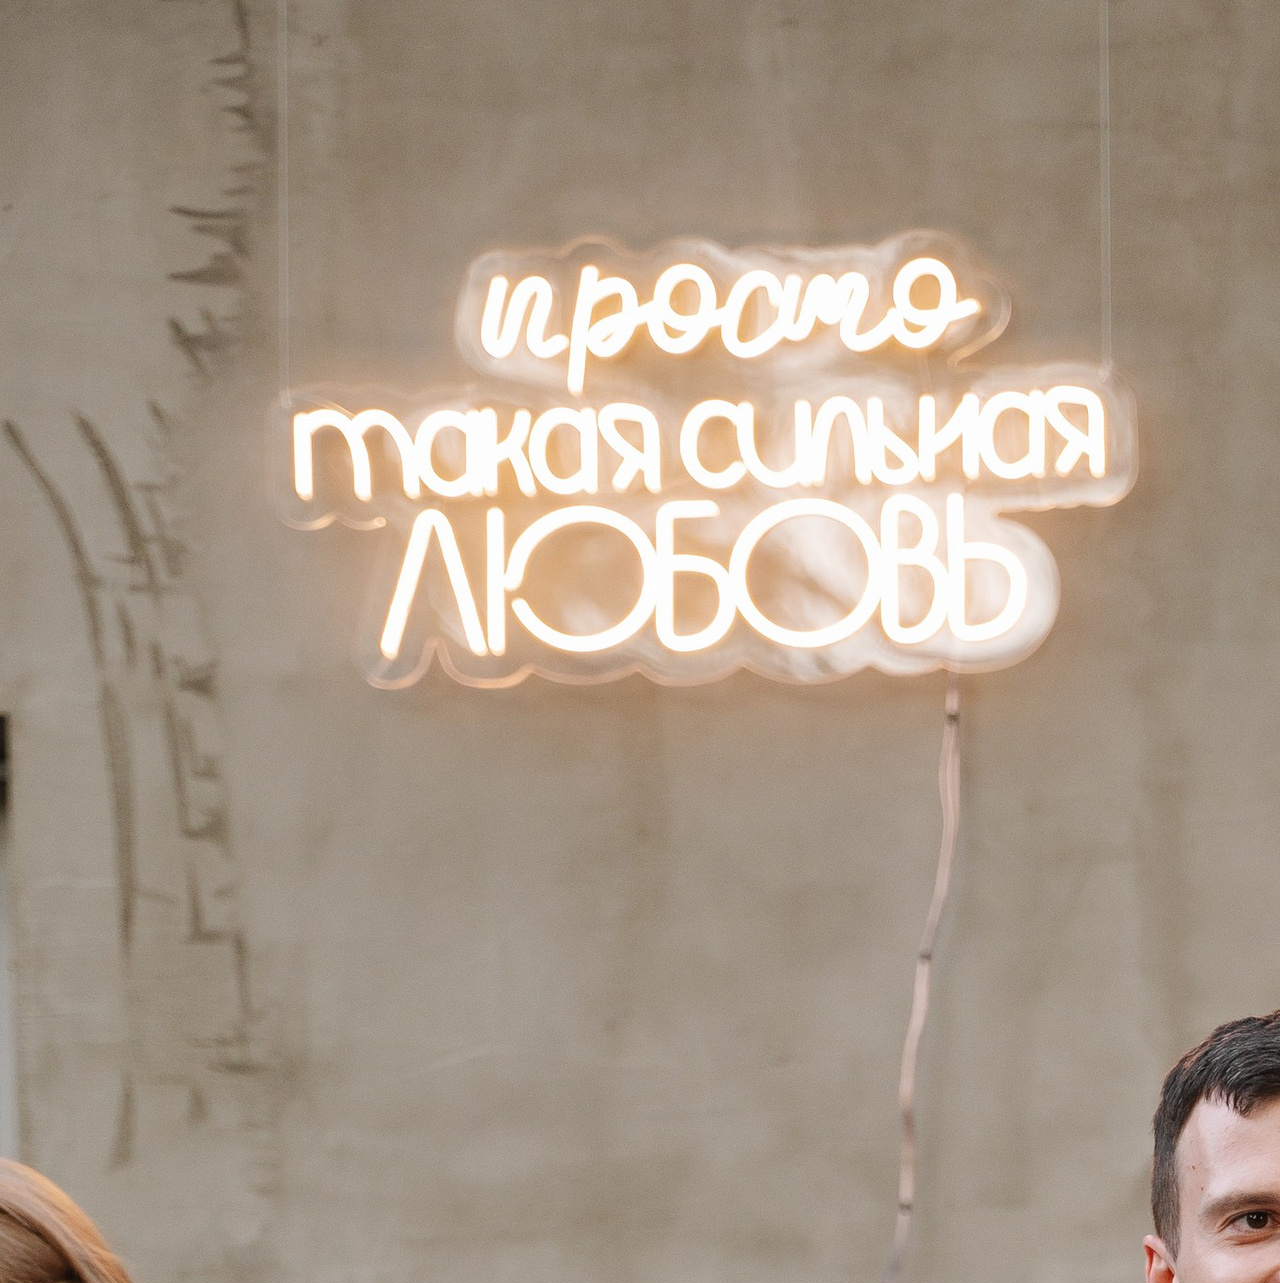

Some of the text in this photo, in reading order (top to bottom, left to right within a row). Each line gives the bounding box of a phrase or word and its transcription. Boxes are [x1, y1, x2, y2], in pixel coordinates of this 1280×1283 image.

[481, 257, 980, 395] просто
[293, 385, 1106, 500] такая сильная
[381, 492, 1028, 657] ЛЮБОВЬ
